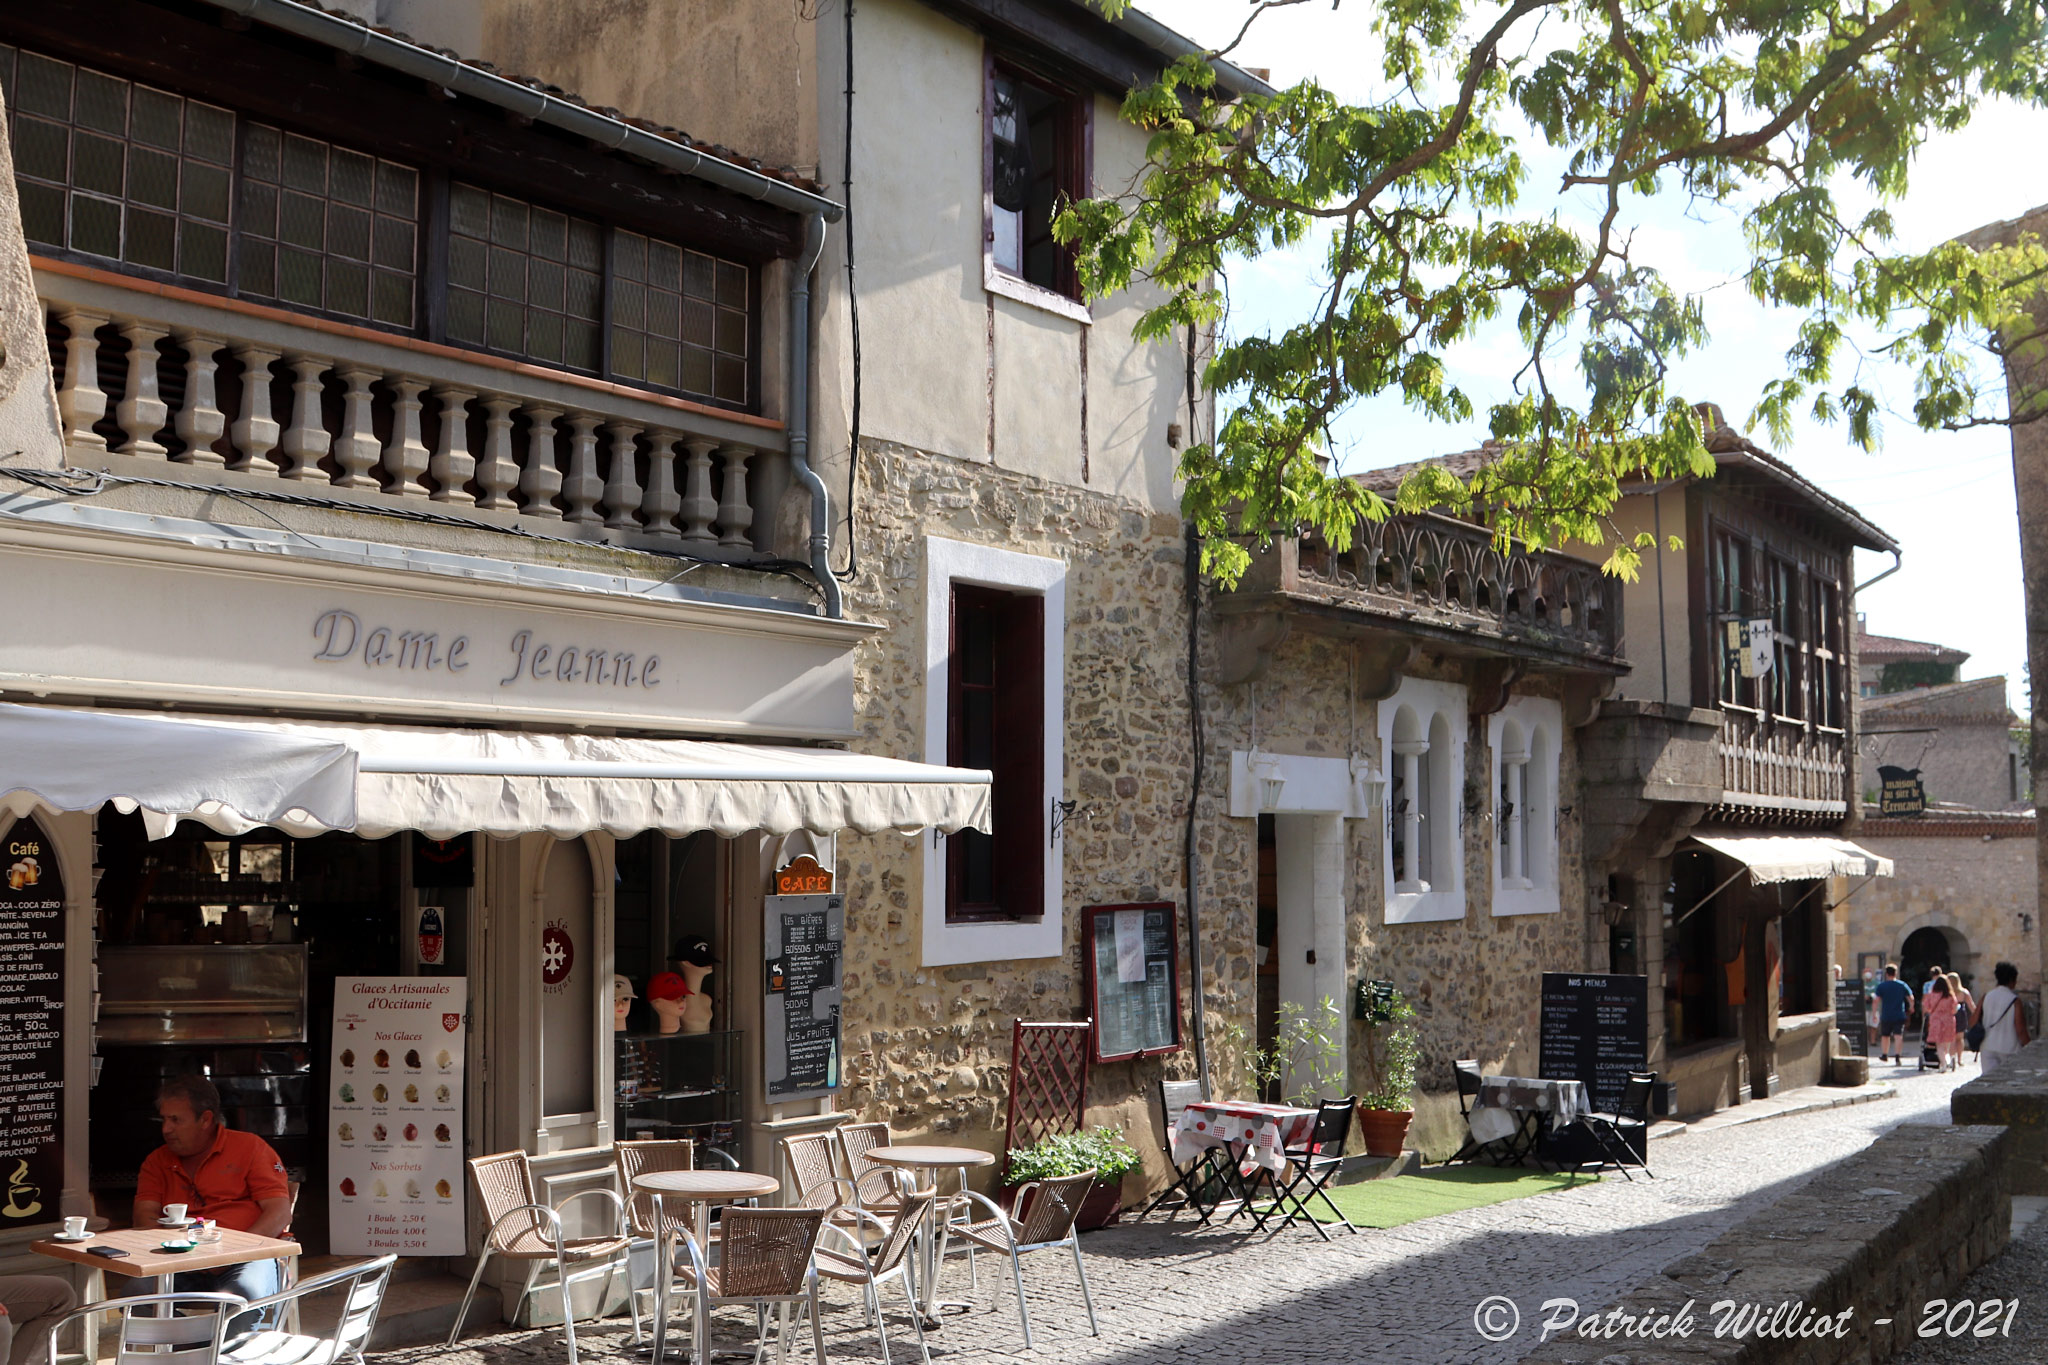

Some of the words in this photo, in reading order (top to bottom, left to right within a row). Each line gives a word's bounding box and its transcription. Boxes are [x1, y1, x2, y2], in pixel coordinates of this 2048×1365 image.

[313, 608, 470, 672] Dame
[500, 629, 661, 689] Jeanne
[1881, 798, 1923, 813] Trencavel
[10, 841, 39, 855] Café
[780, 873, 828, 891] CAFÉ
[18, 901, 39, 909] COCA
[41, 899, 61, 909] ZÉRO
[0, 911, 17, 919] RITE
[784, 915, 794, 926] LES
[801, 913, 822, 925] BIÈRES
[32, 931, 47, 939] TEA
[39, 942, 64, 950] AGRUM
[785, 943, 811, 954] BOISSONS
[815, 942, 838, 952] CHAUDES
[0, 953, 12, 961] SIS
[18, 952, 33, 960] GINI
[19, 963, 44, 971] FRUITS
[30, 972, 59, 980] DIABOLO
[1568, 978, 1581, 987] NOS
[1584, 978, 1607, 987] MENUS
[0, 984, 26, 992] COLAC
[352, 983, 387, 994] Glaces
[389, 983, 450, 994] Artisanales
[44, 1001, 64, 1009] SIROP
[368, 997, 432, 1010] d'Occitanie
[785, 999, 809, 1010] SODAS
[15, 1010, 49, 1020] PRESSION
[28, 1031, 59, 1040] MONACO
[375, 1032, 392, 1041] Nos
[393, 1032, 422, 1041] Glaces
[786, 1031, 800, 1041] JUS
[807, 1027, 830, 1038] FRUITS
[12, 1040, 52, 1050] BOUTEILLE
[12, 1071, 46, 1081] BLANCHE
[27, 1090, 55, 1101] AMBRÉE
[18, 1102, 56, 1113] BOUTEILLE
[11, 1138, 21, 1147] AU
[41, 1132, 55, 1143] THÉ
[370, 1162, 387, 1171] Nos
[389, 1162, 422, 1172] Sorbets
[374, 1214, 396, 1222] Boule
[367, 1227, 372, 1235] 2
[374, 1227, 399, 1235] Boules
[367, 1240, 372, 1248] 3
[374, 1240, 400, 1248] Boules
